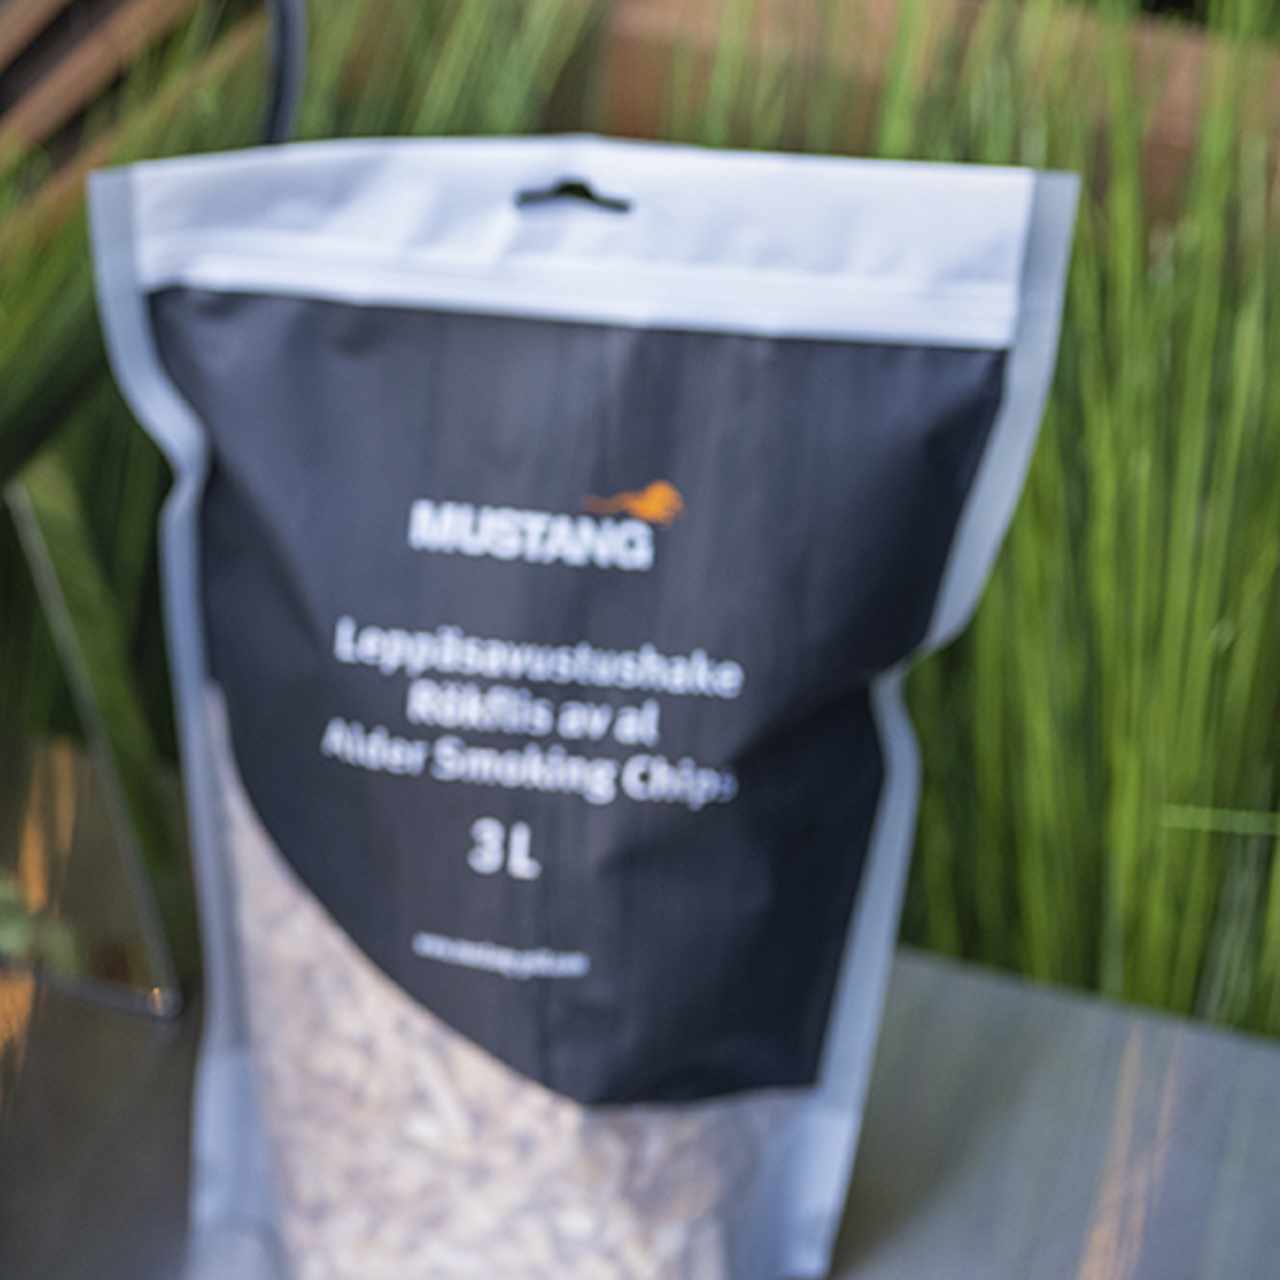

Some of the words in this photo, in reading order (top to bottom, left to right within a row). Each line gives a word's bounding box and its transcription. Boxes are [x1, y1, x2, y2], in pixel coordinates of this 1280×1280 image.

[408, 499, 655, 570] MUSTANG
[431, 734, 618, 804] Smoking
[468, 817, 505, 875] 3
[506, 821, 541, 880] L
